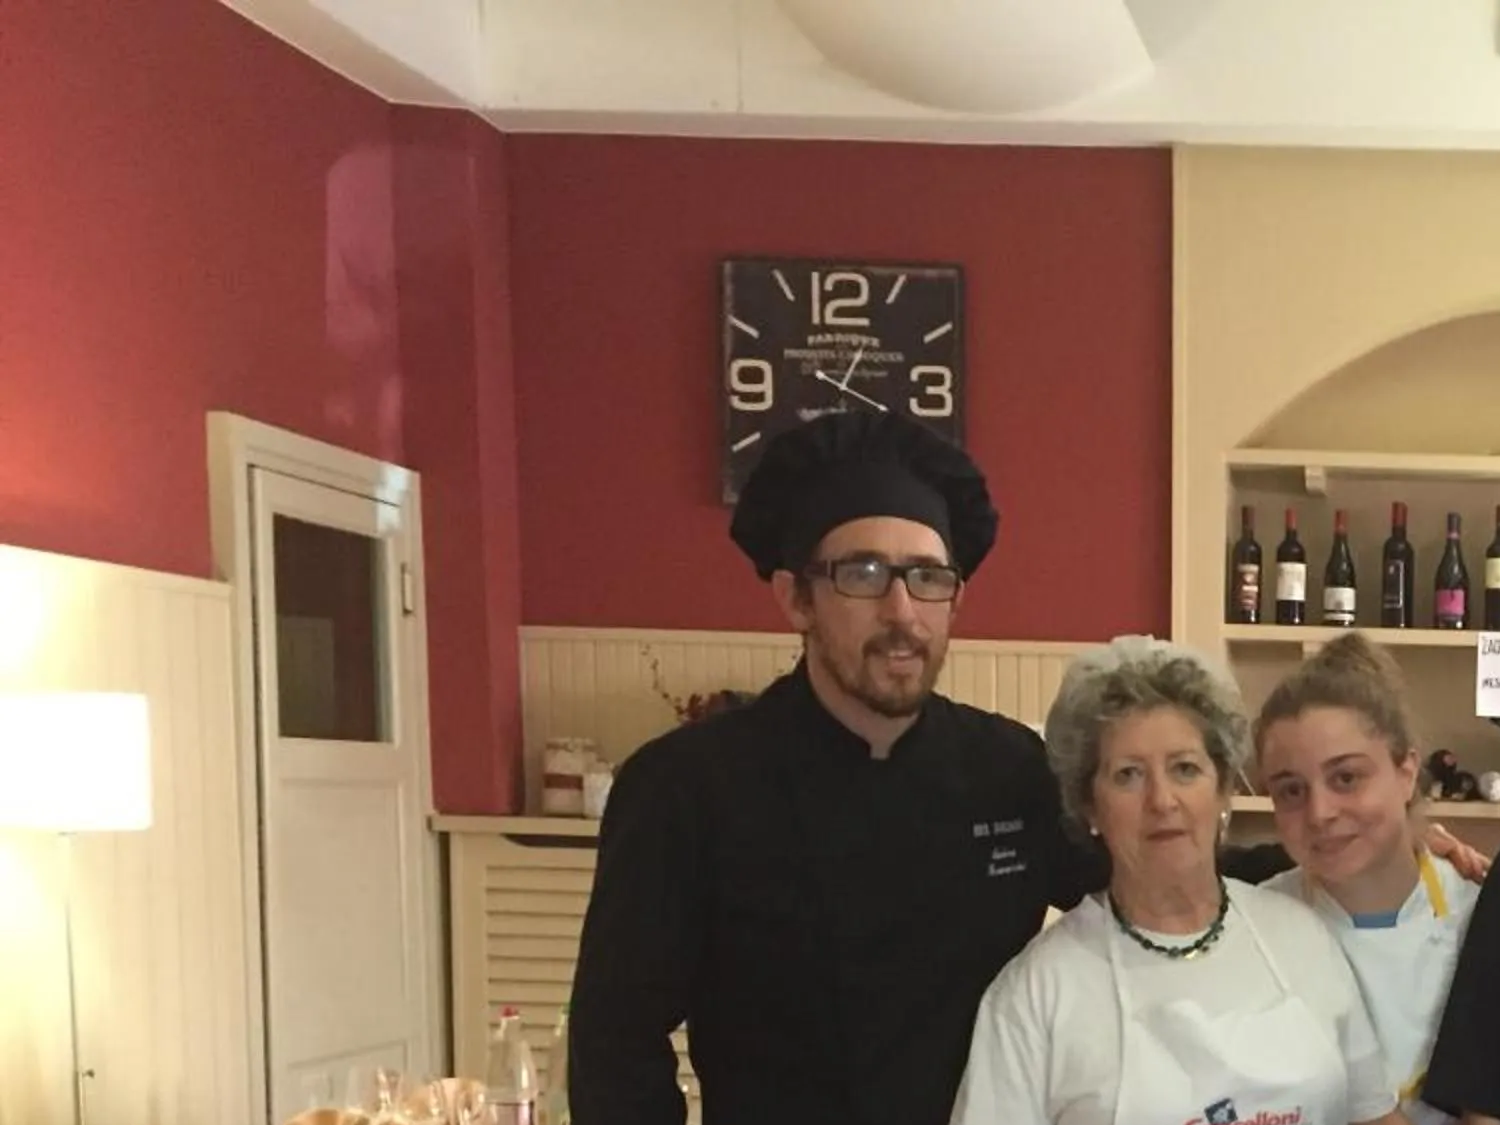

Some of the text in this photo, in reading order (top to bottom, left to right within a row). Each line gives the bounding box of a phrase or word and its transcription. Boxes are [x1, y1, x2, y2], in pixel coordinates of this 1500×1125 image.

[811, 271, 870, 327] 12
[730, 358, 774, 412] 9
[909, 365, 953, 417] 3
